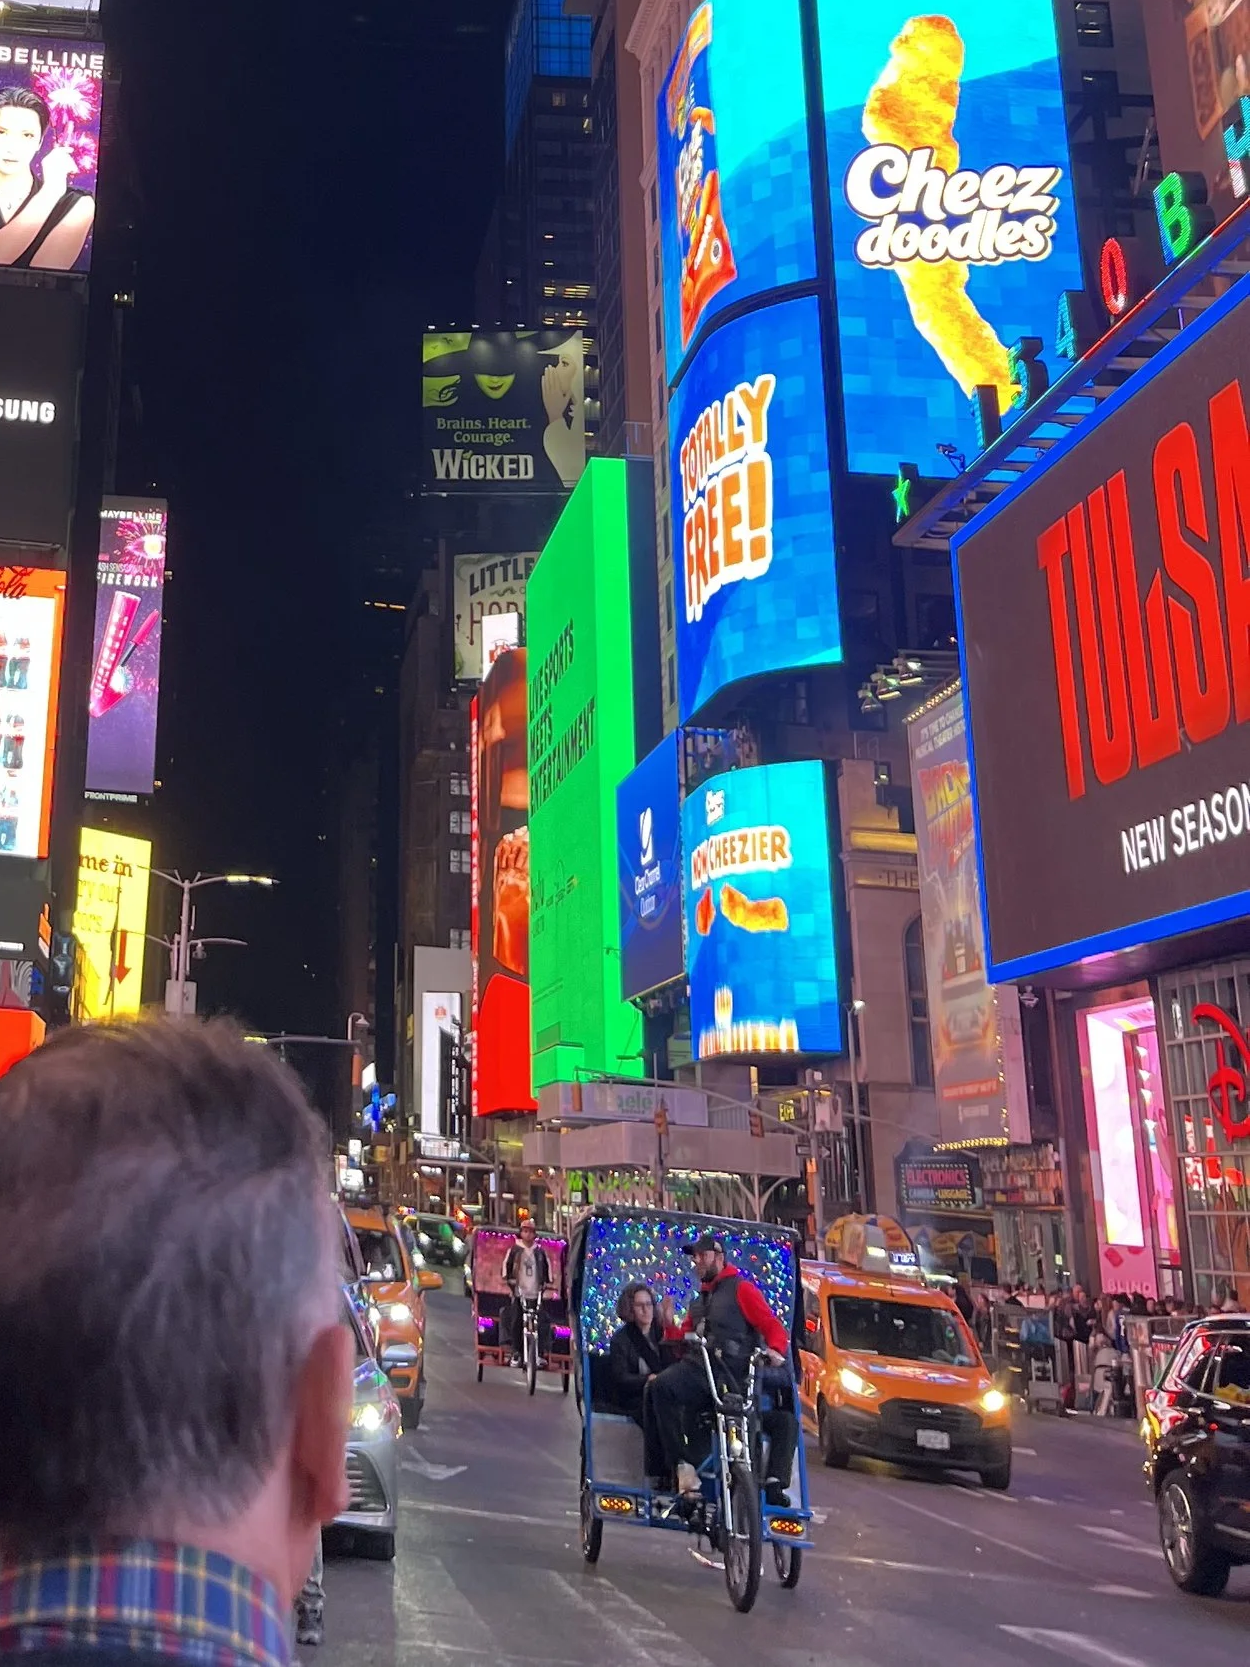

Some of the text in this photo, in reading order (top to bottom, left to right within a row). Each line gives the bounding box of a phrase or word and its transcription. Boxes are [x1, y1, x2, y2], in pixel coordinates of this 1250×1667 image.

[30, 65, 102, 79] NEW YORK
[845, 144, 1061, 221] Cheez
[855, 209, 1054, 267] doodles
[436, 417, 531, 430] Brains. Heart.
[453, 431, 514, 446] Courage.
[681, 376, 774, 503] TOTALLY
[432, 449, 534, 480] WICKED
[684, 453, 771, 622] FREE!
[470, 557, 534, 596] LITTLE
[708, 829, 790, 872] CHEEZIER
[1120, 816, 1165, 874] NEW
[905, 1168, 966, 1186] ELECTRONICS
